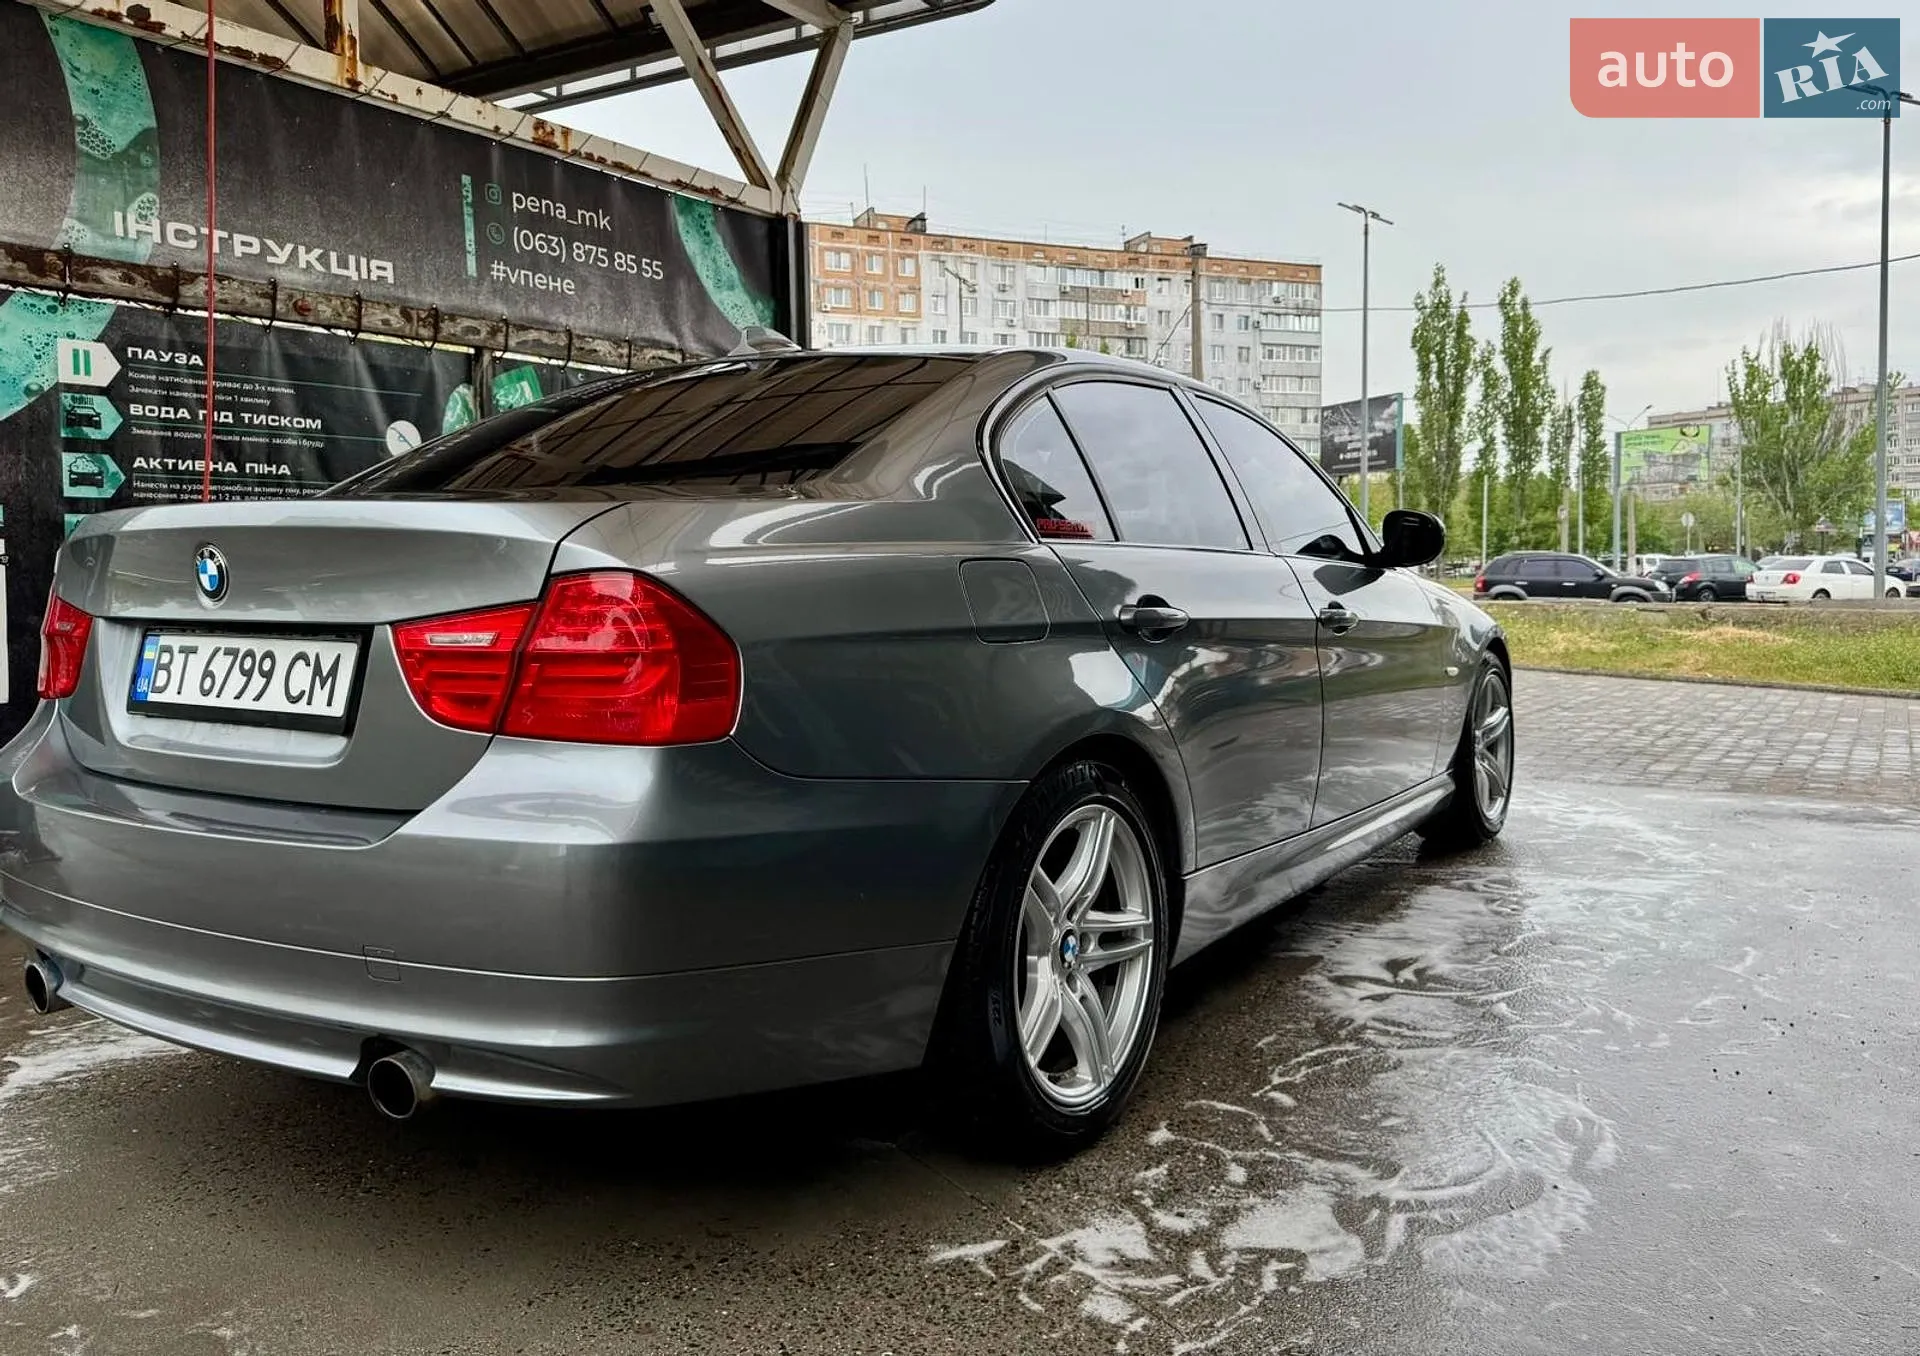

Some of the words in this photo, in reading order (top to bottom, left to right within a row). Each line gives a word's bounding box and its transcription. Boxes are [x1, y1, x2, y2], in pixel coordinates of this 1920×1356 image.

[511, 190, 613, 232] pena_mk
[113, 210, 395, 285] ІНСТРУКЦІЯ
[512, 226, 566, 263] (063)
[572, 242, 609, 268] 875
[614, 252, 638, 274] 85
[641, 259, 664, 280] 55
[127, 346, 204, 367] ПАУЗА
[129, 403, 191, 420] ВОДА
[240, 412, 322, 430] ТИСКОМ
[133, 456, 238, 473] АКТИВНА
[245, 463, 291, 476] ПІНА
[150, 645, 199, 694] BT
[199, 647, 277, 702] 6799
[284, 651, 342, 707] CM
